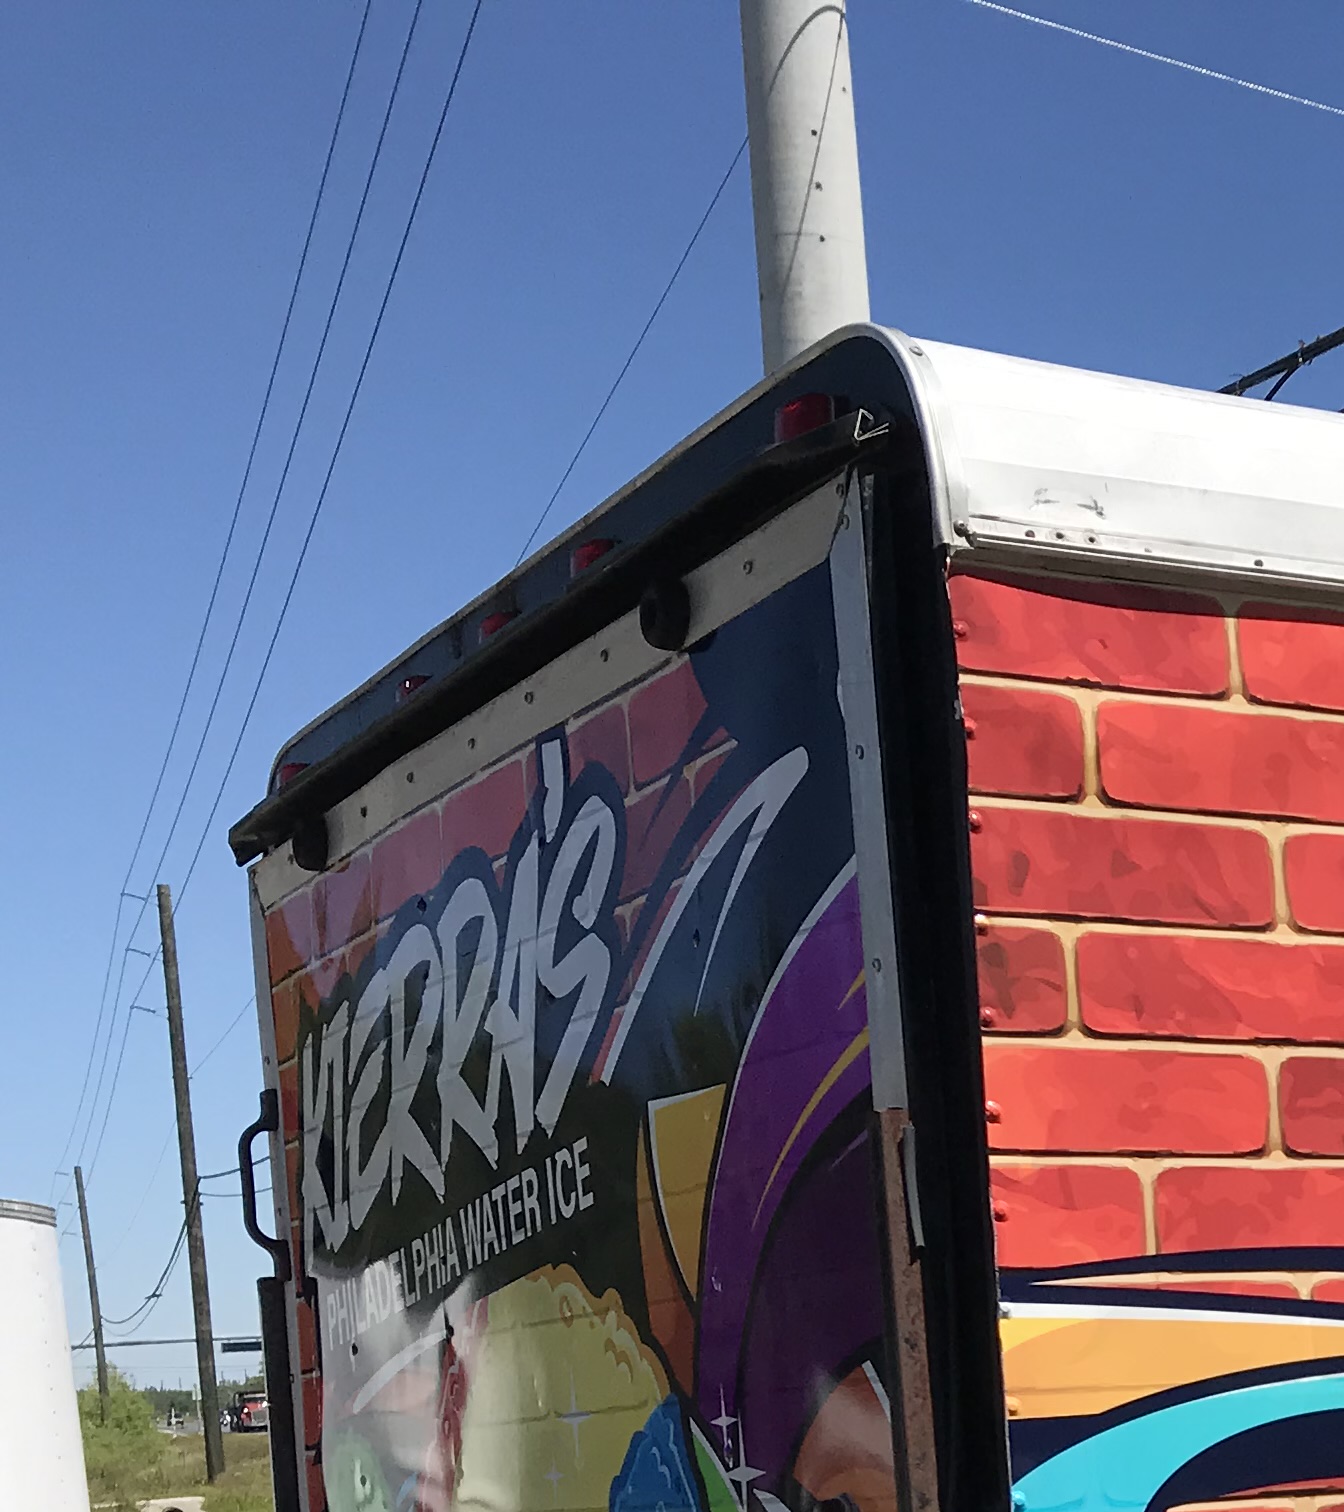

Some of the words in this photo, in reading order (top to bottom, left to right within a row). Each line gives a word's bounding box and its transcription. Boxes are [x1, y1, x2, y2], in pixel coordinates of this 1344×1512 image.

[301, 738, 617, 1275] KIERRA'S
[326, 1216, 461, 1351] PHILADELPHIA
[458, 1166, 543, 1271] WATER
[545, 1135, 595, 1226] ICE
